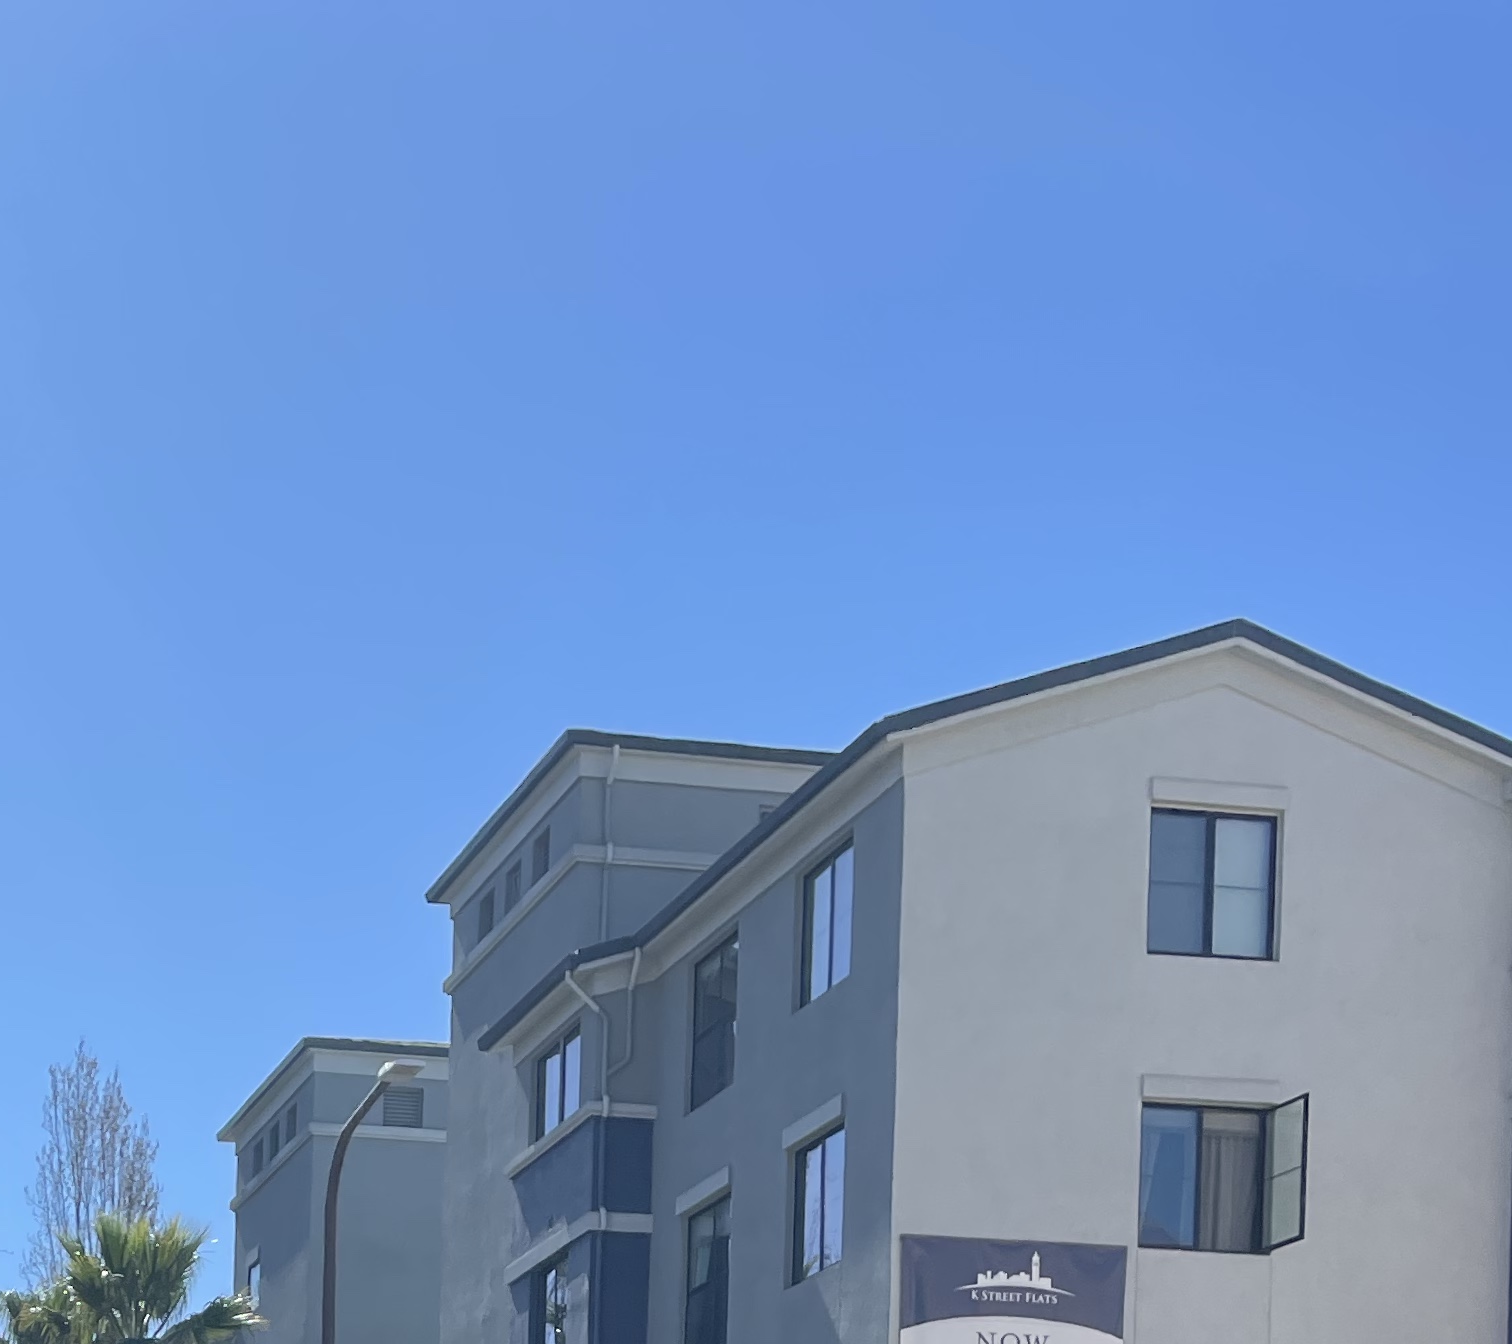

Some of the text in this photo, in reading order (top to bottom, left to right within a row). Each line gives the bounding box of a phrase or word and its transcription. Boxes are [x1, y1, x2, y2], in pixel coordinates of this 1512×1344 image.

[971, 1289, 1058, 1305] K STREET FLATS
